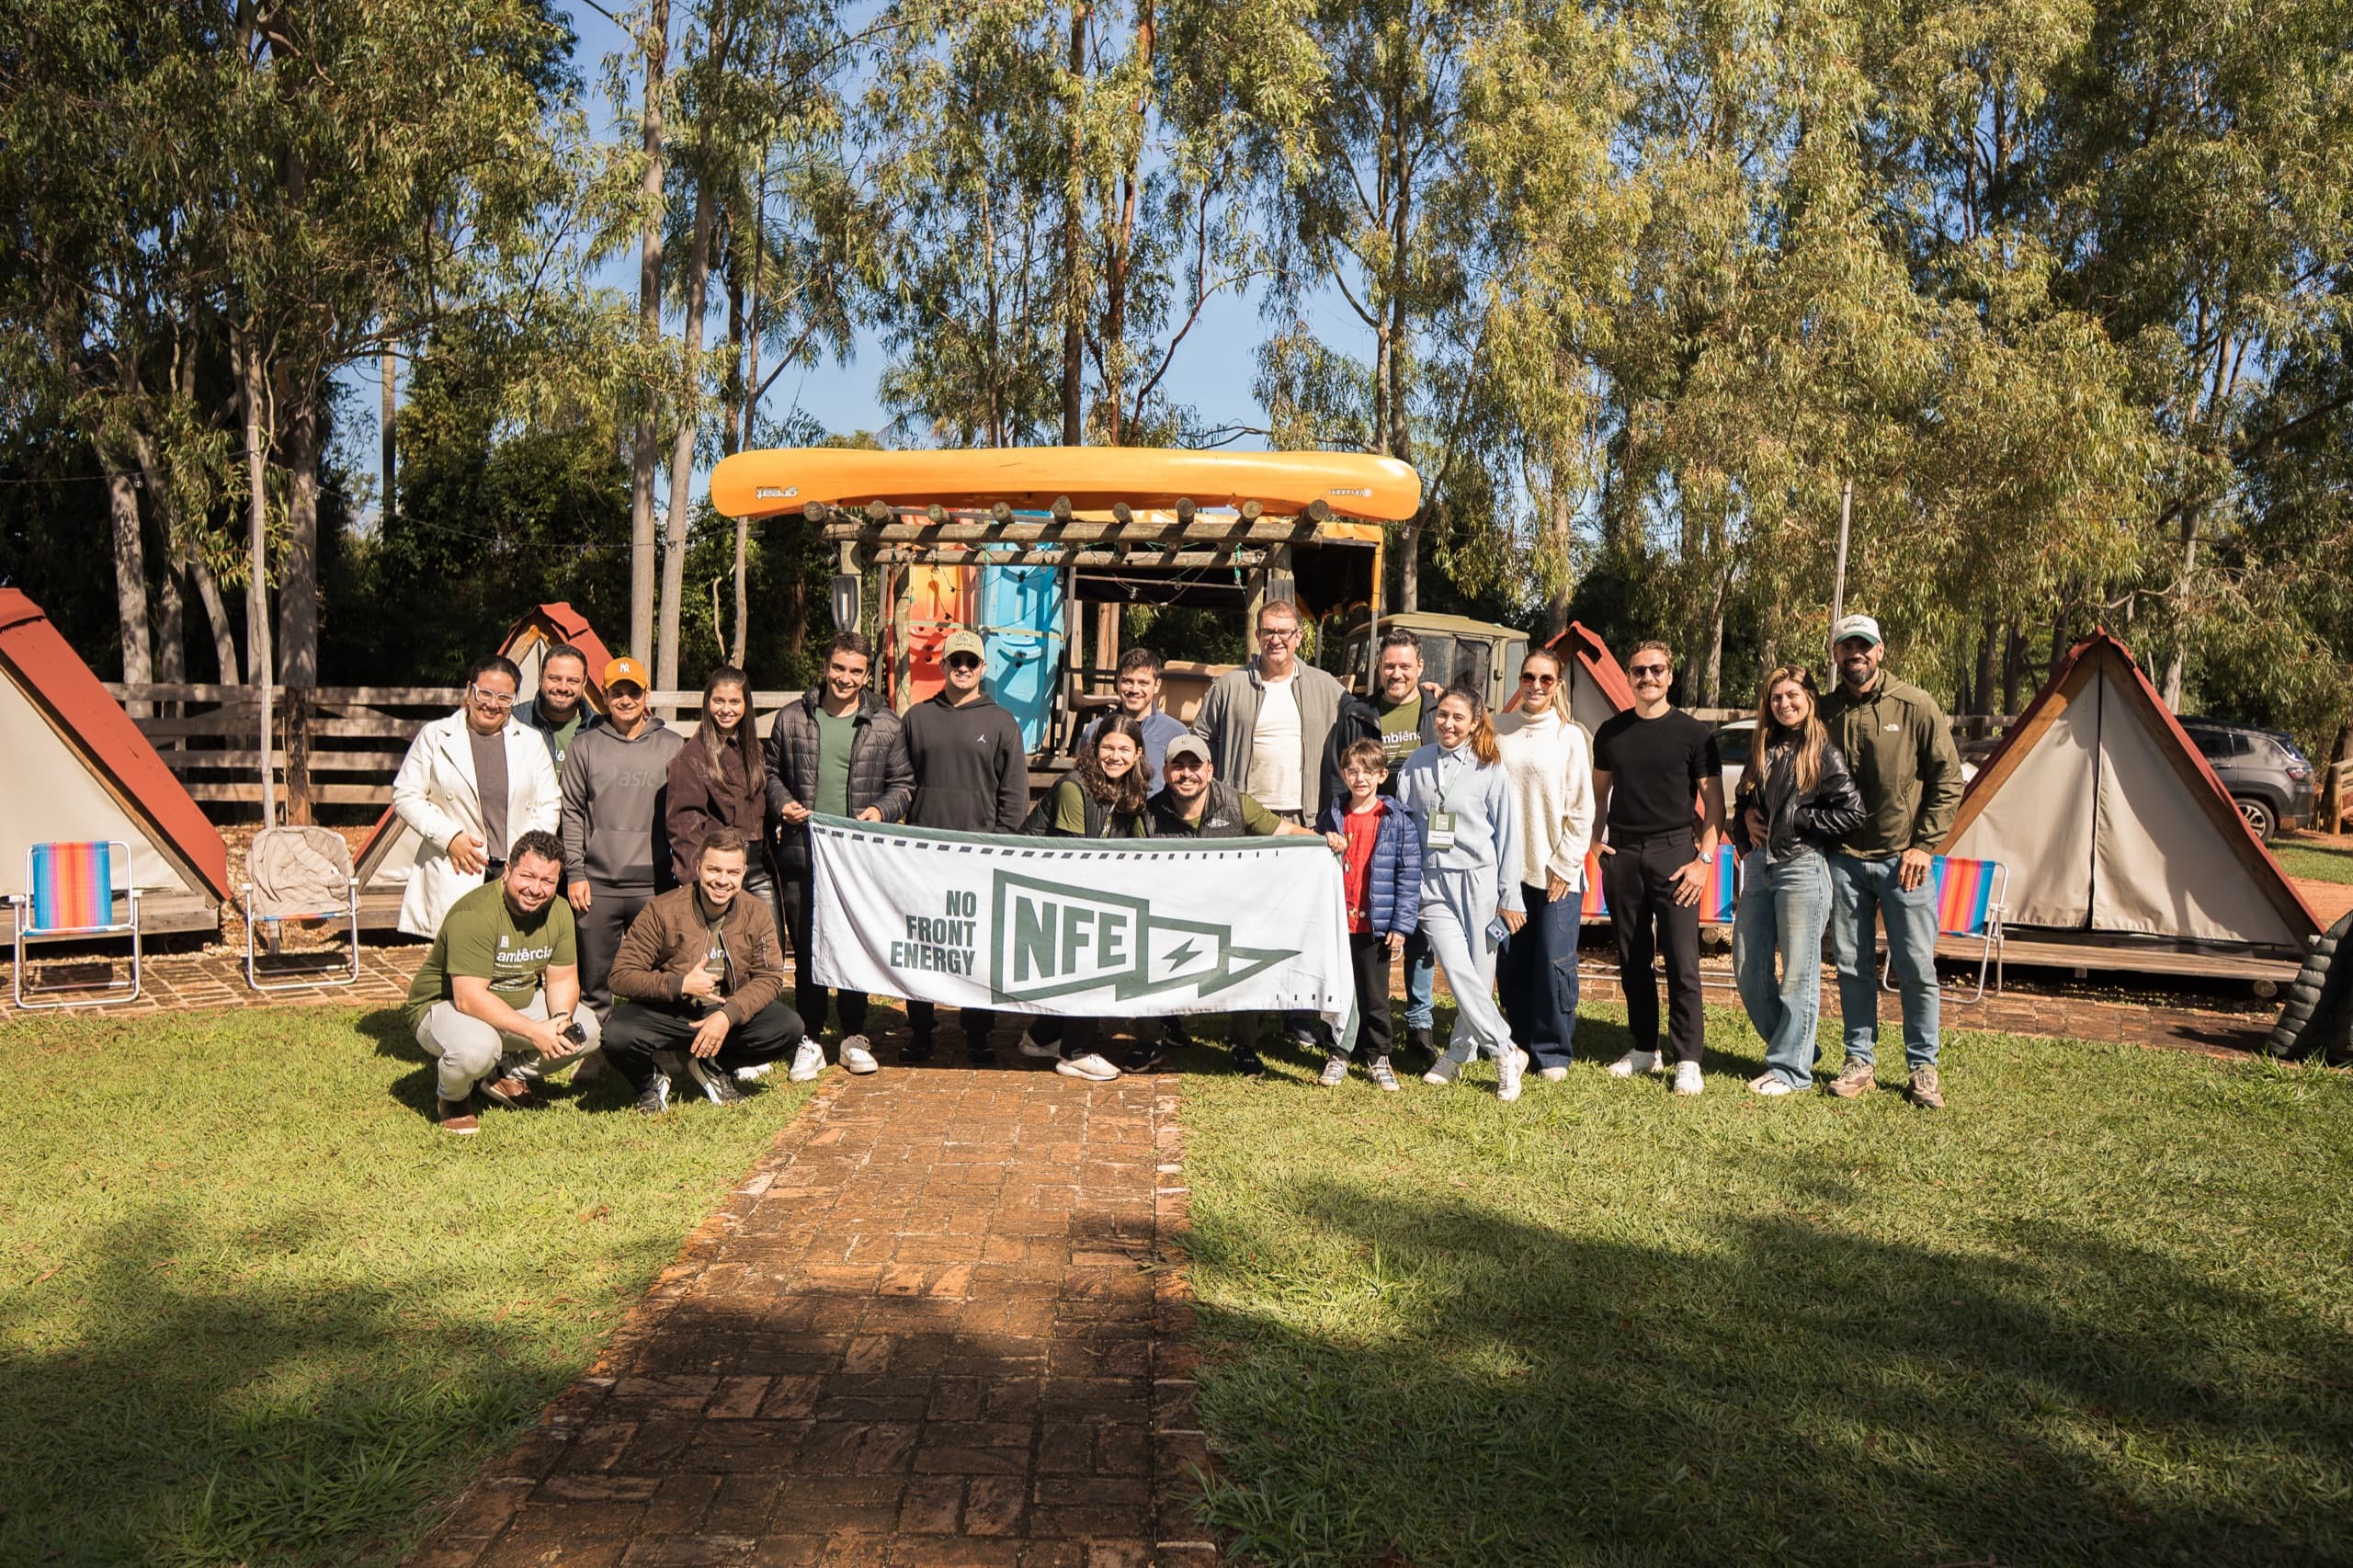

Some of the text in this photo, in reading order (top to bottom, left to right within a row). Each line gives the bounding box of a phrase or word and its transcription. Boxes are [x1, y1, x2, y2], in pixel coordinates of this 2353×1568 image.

[946, 890, 977, 918] NO
[905, 915, 977, 948] FRONT
[1013, 895, 1128, 983] NFE
[890, 940, 976, 977] ENERGY
